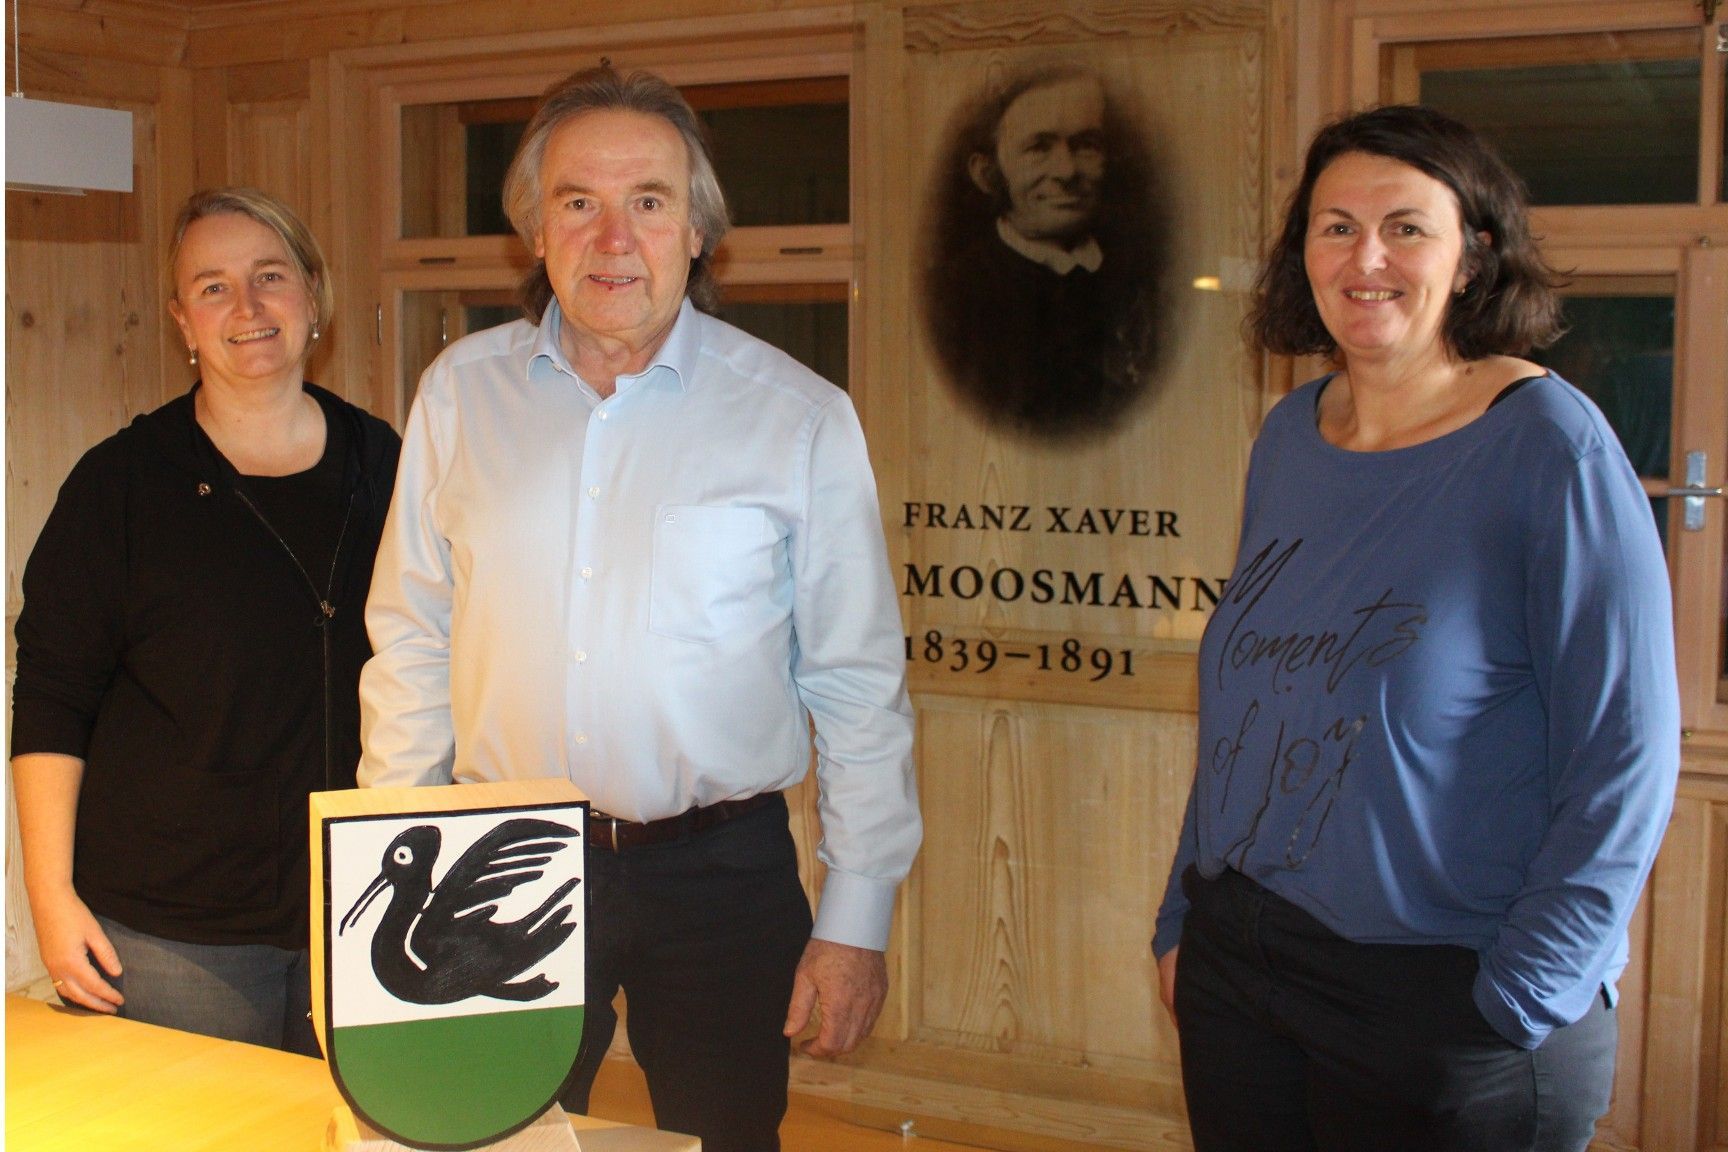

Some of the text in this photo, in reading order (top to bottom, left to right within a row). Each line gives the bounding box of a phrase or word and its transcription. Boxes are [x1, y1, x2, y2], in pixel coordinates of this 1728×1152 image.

[903, 502, 1181, 538] FRANZ XAVER
[902, 563, 1231, 612] MOOSMANN
[1212, 699, 1259, 815] of
